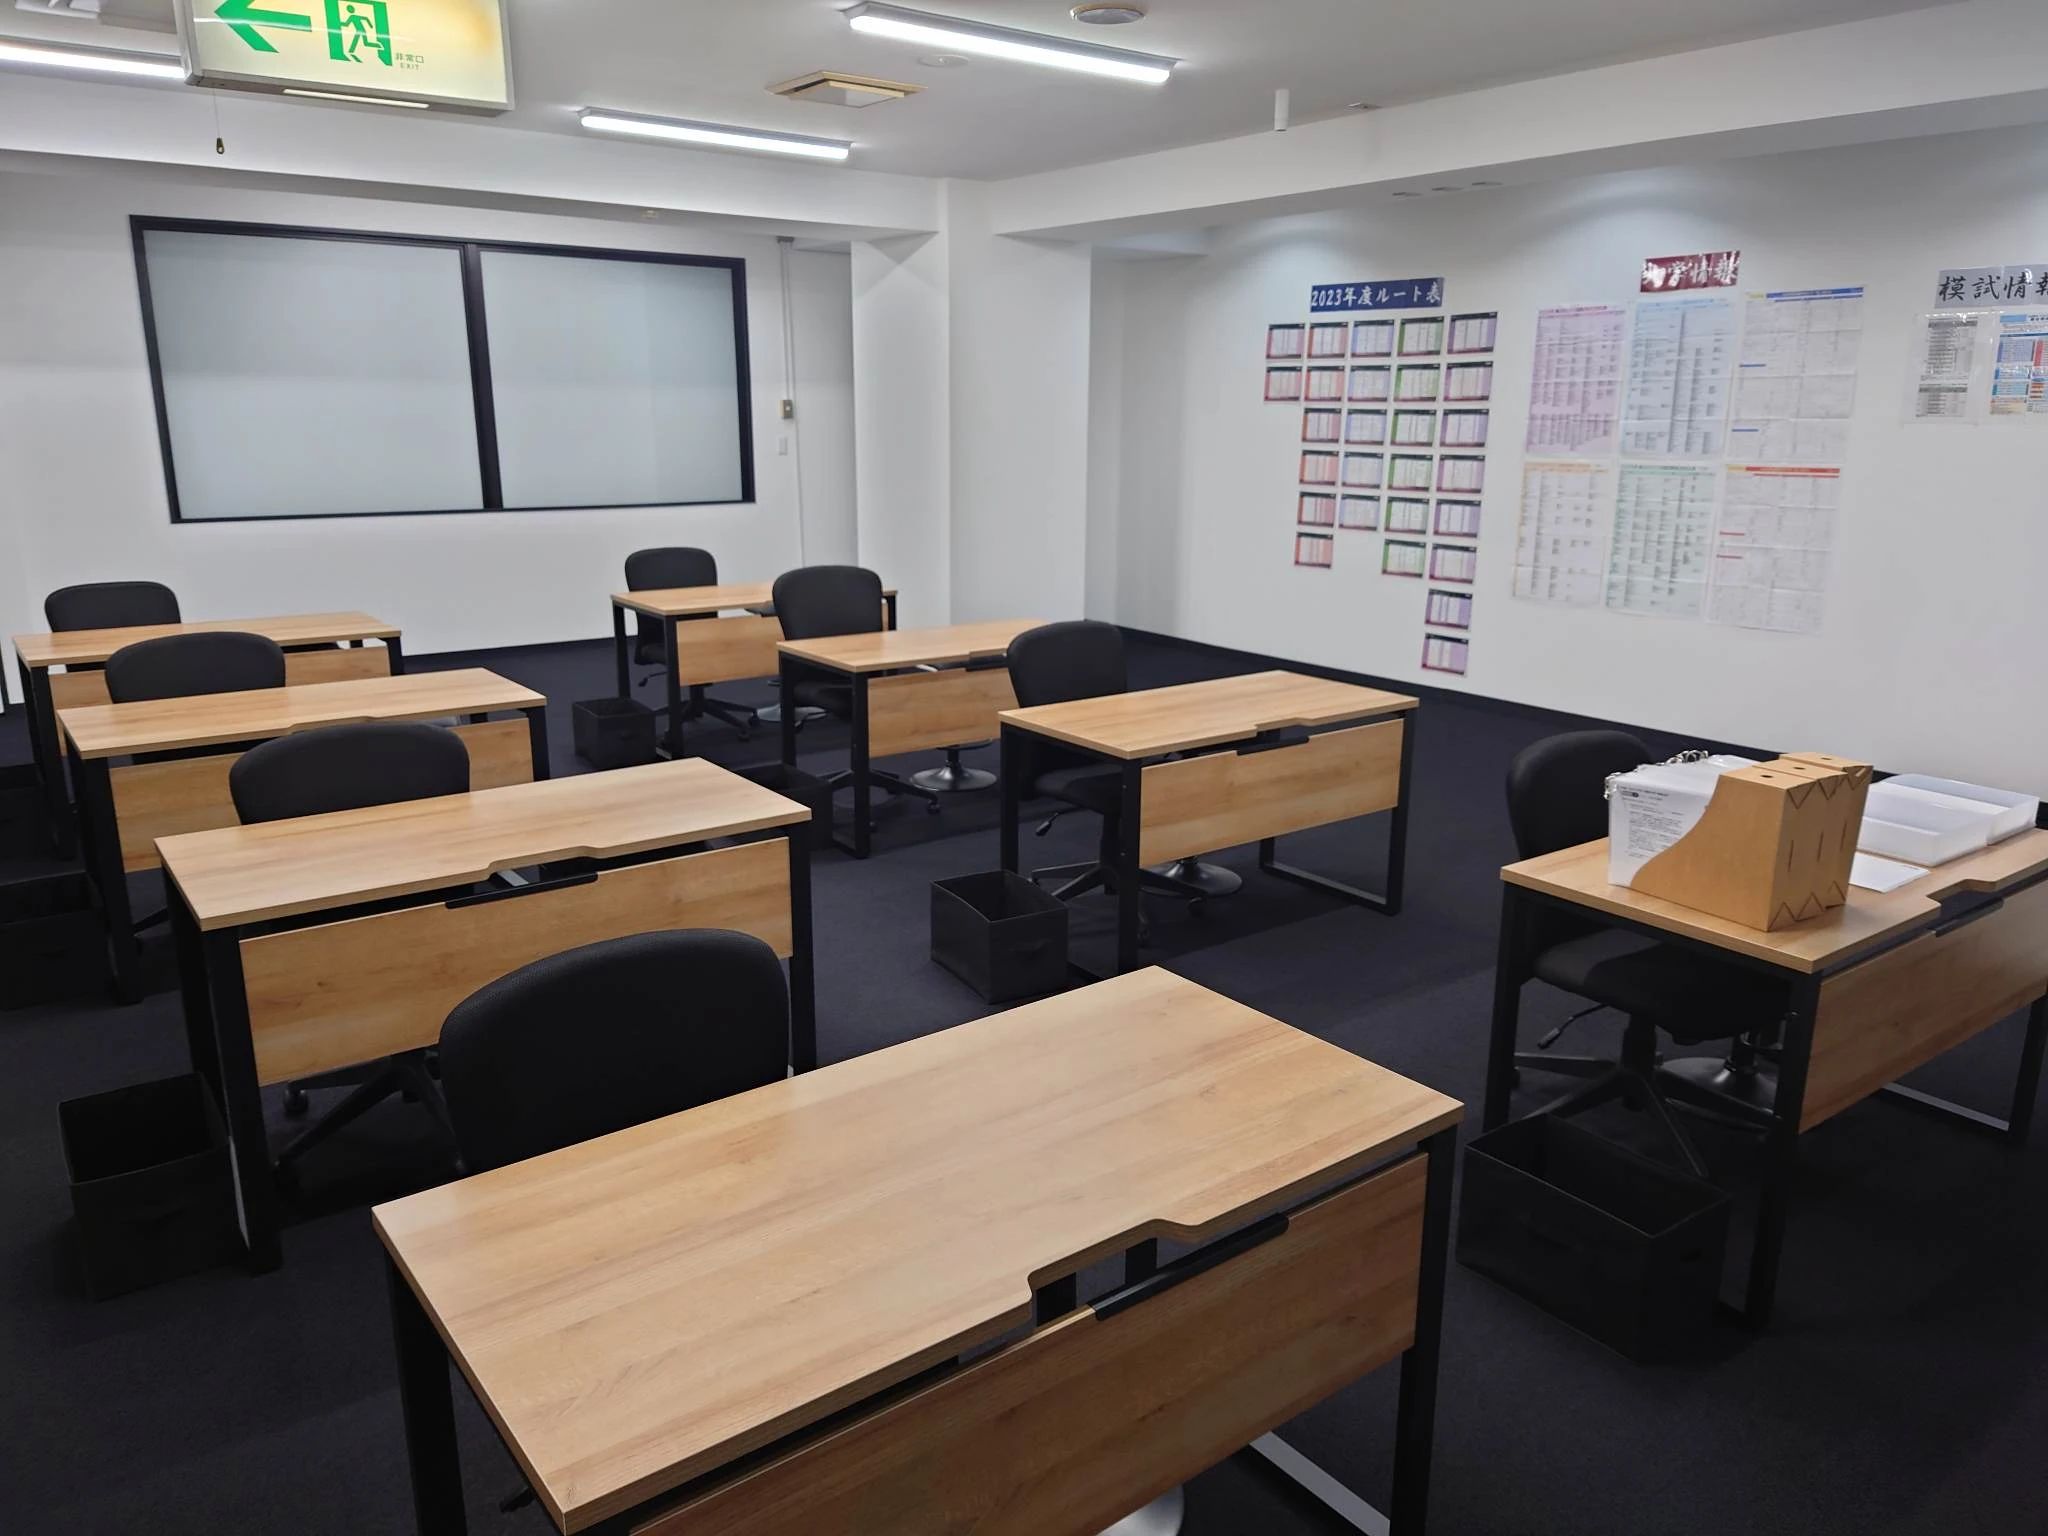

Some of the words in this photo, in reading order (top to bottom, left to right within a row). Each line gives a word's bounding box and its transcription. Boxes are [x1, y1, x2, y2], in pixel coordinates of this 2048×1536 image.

[1311, 281, 1441, 307] 2023年度ルート表
